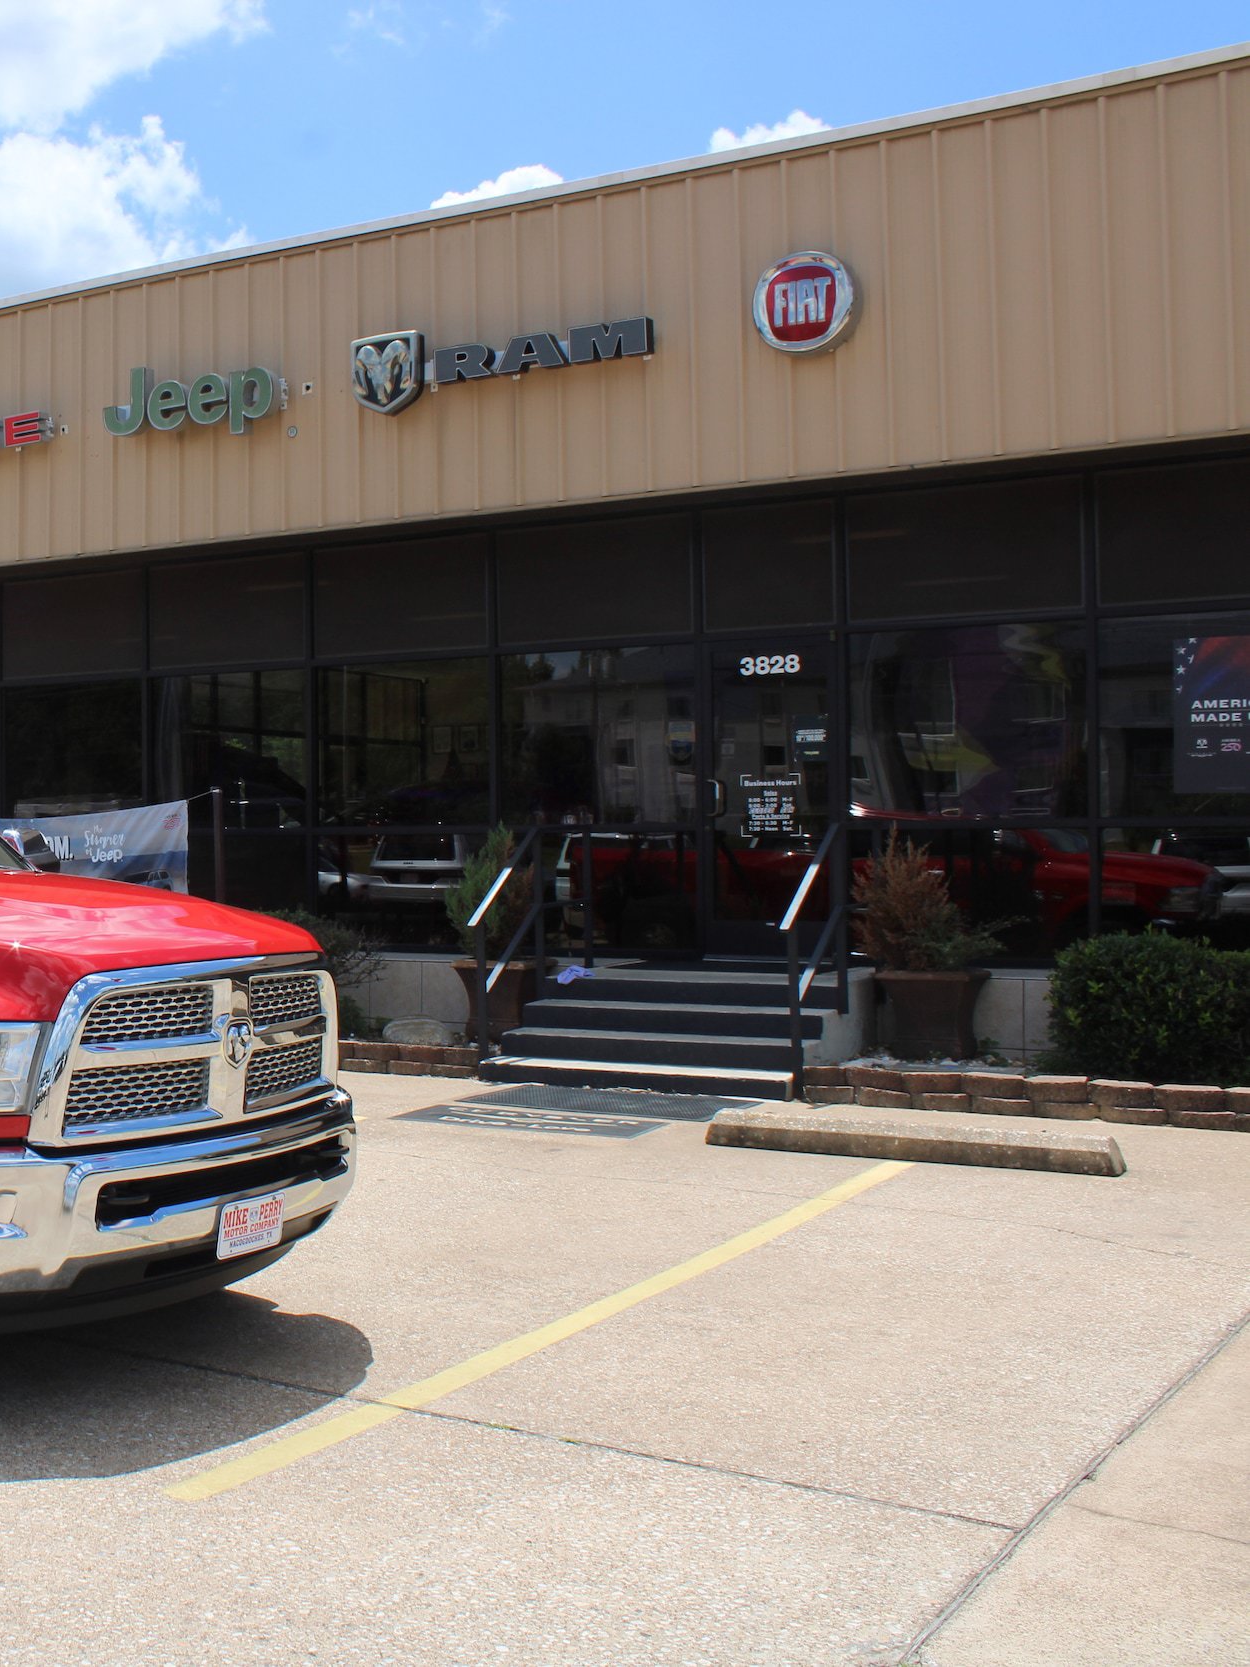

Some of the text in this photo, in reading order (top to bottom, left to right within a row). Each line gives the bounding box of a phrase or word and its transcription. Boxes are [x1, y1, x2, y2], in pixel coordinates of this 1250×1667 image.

[773, 276, 831, 328] FIAT
[432, 316, 653, 384] RAM
[102, 366, 274, 437] Jeep
[740, 654, 800, 676] 3828
[1191, 713, 1242, 722] MADE
[223, 1199, 283, 1229] MIKE PERRY
[223, 1218, 279, 1239] MOTOR COMPANY
